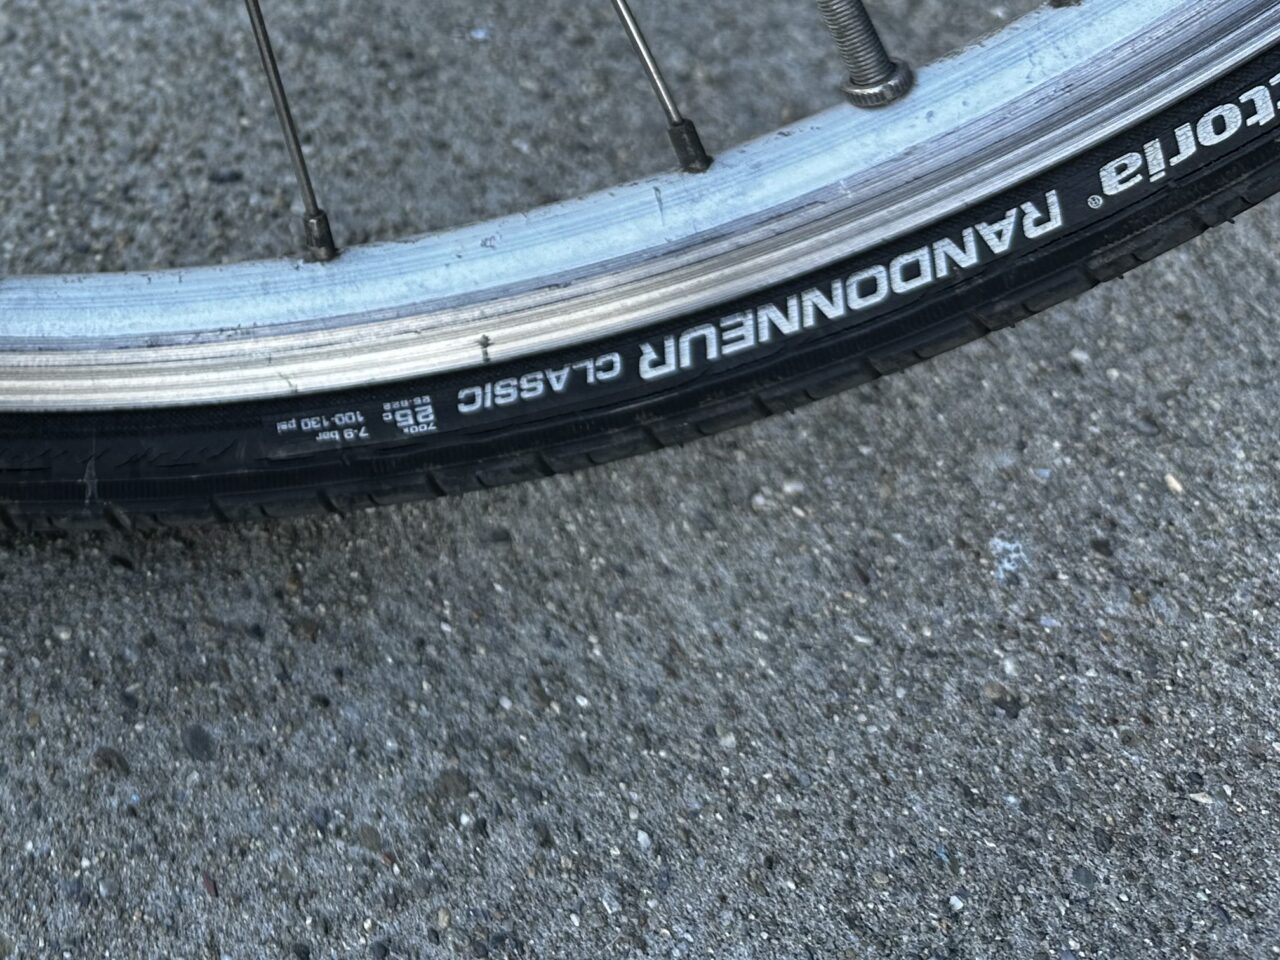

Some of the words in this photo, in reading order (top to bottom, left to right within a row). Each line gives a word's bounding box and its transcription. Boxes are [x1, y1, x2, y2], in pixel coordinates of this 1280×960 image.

[638, 190, 1063, 381] RANDONNEUR
[457, 351, 622, 414] CLASSIC
[275, 418, 298, 434] psi
[300, 410, 365, 431] 100-130
[315, 428, 339, 442] bar
